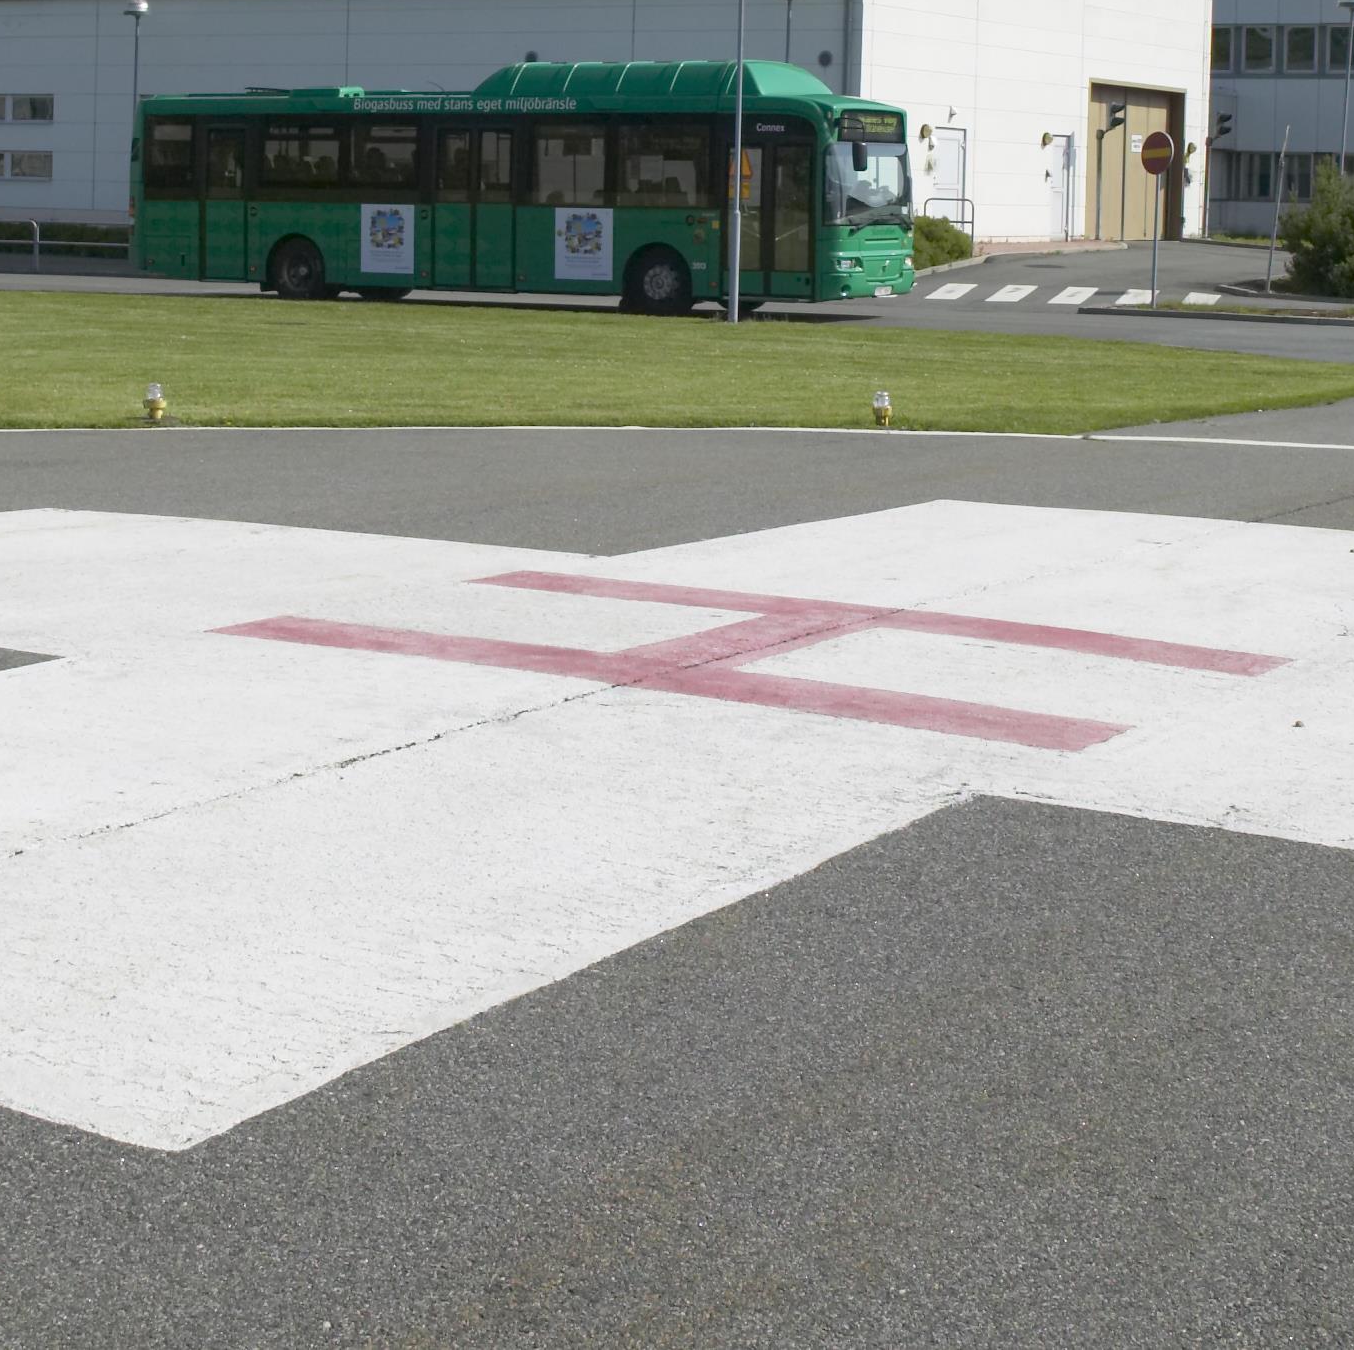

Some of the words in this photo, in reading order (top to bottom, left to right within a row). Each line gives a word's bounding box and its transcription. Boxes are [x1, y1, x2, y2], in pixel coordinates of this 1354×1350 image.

[353, 98, 414, 112] Biogasbuss
[417, 98, 442, 110] med
[444, 99, 474, 110] stans
[476, 100, 502, 112] eget
[505, 97, 577, 112] miljöbränsle
[756, 123, 785, 132] Connex
[205, 569, 1296, 752] H
